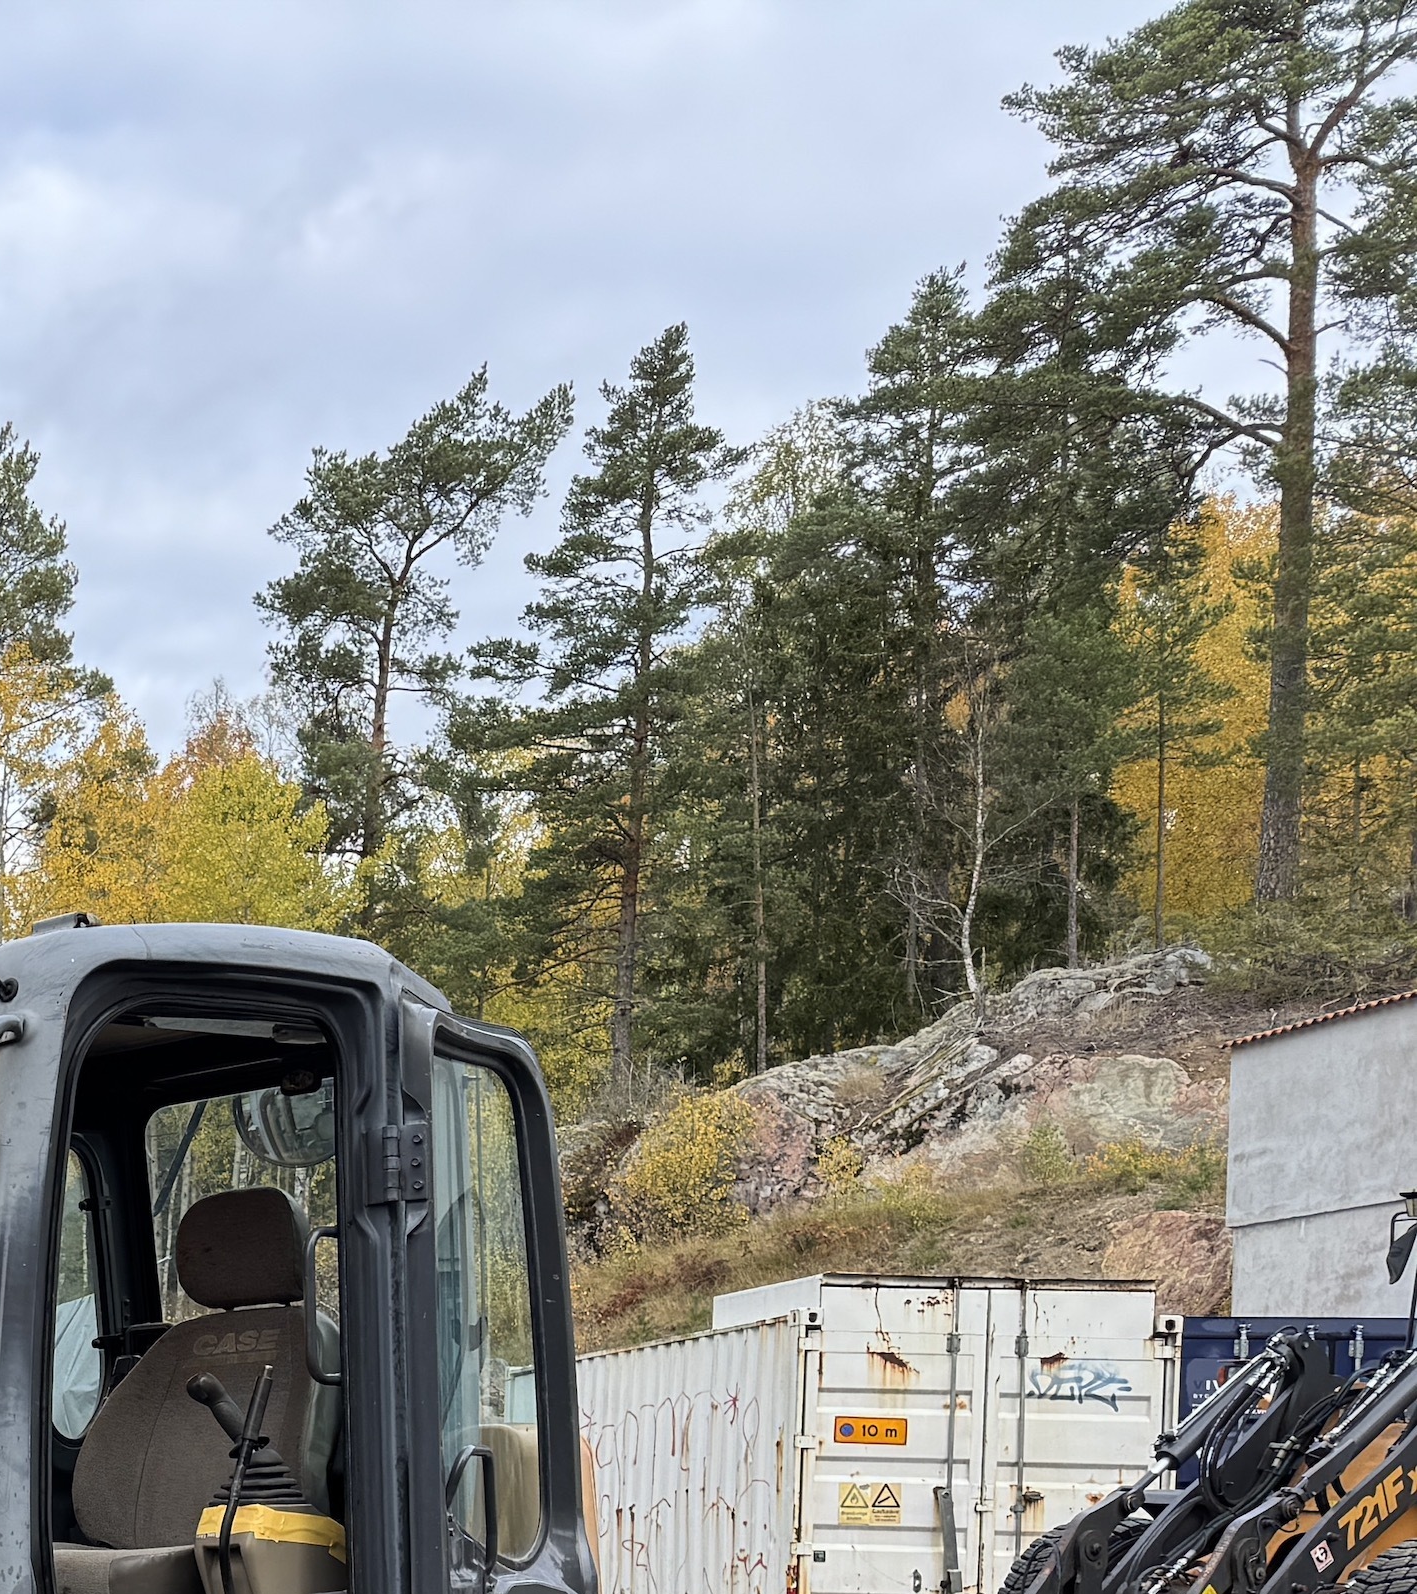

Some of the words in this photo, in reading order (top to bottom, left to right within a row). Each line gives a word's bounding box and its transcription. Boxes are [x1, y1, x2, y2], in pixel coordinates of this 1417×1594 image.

[192, 1328, 281, 1356] CASE
[862, 1424, 878, 1437] 10
[885, 1428, 898, 1438] m
[1338, 1465, 1404, 1551] 721F
